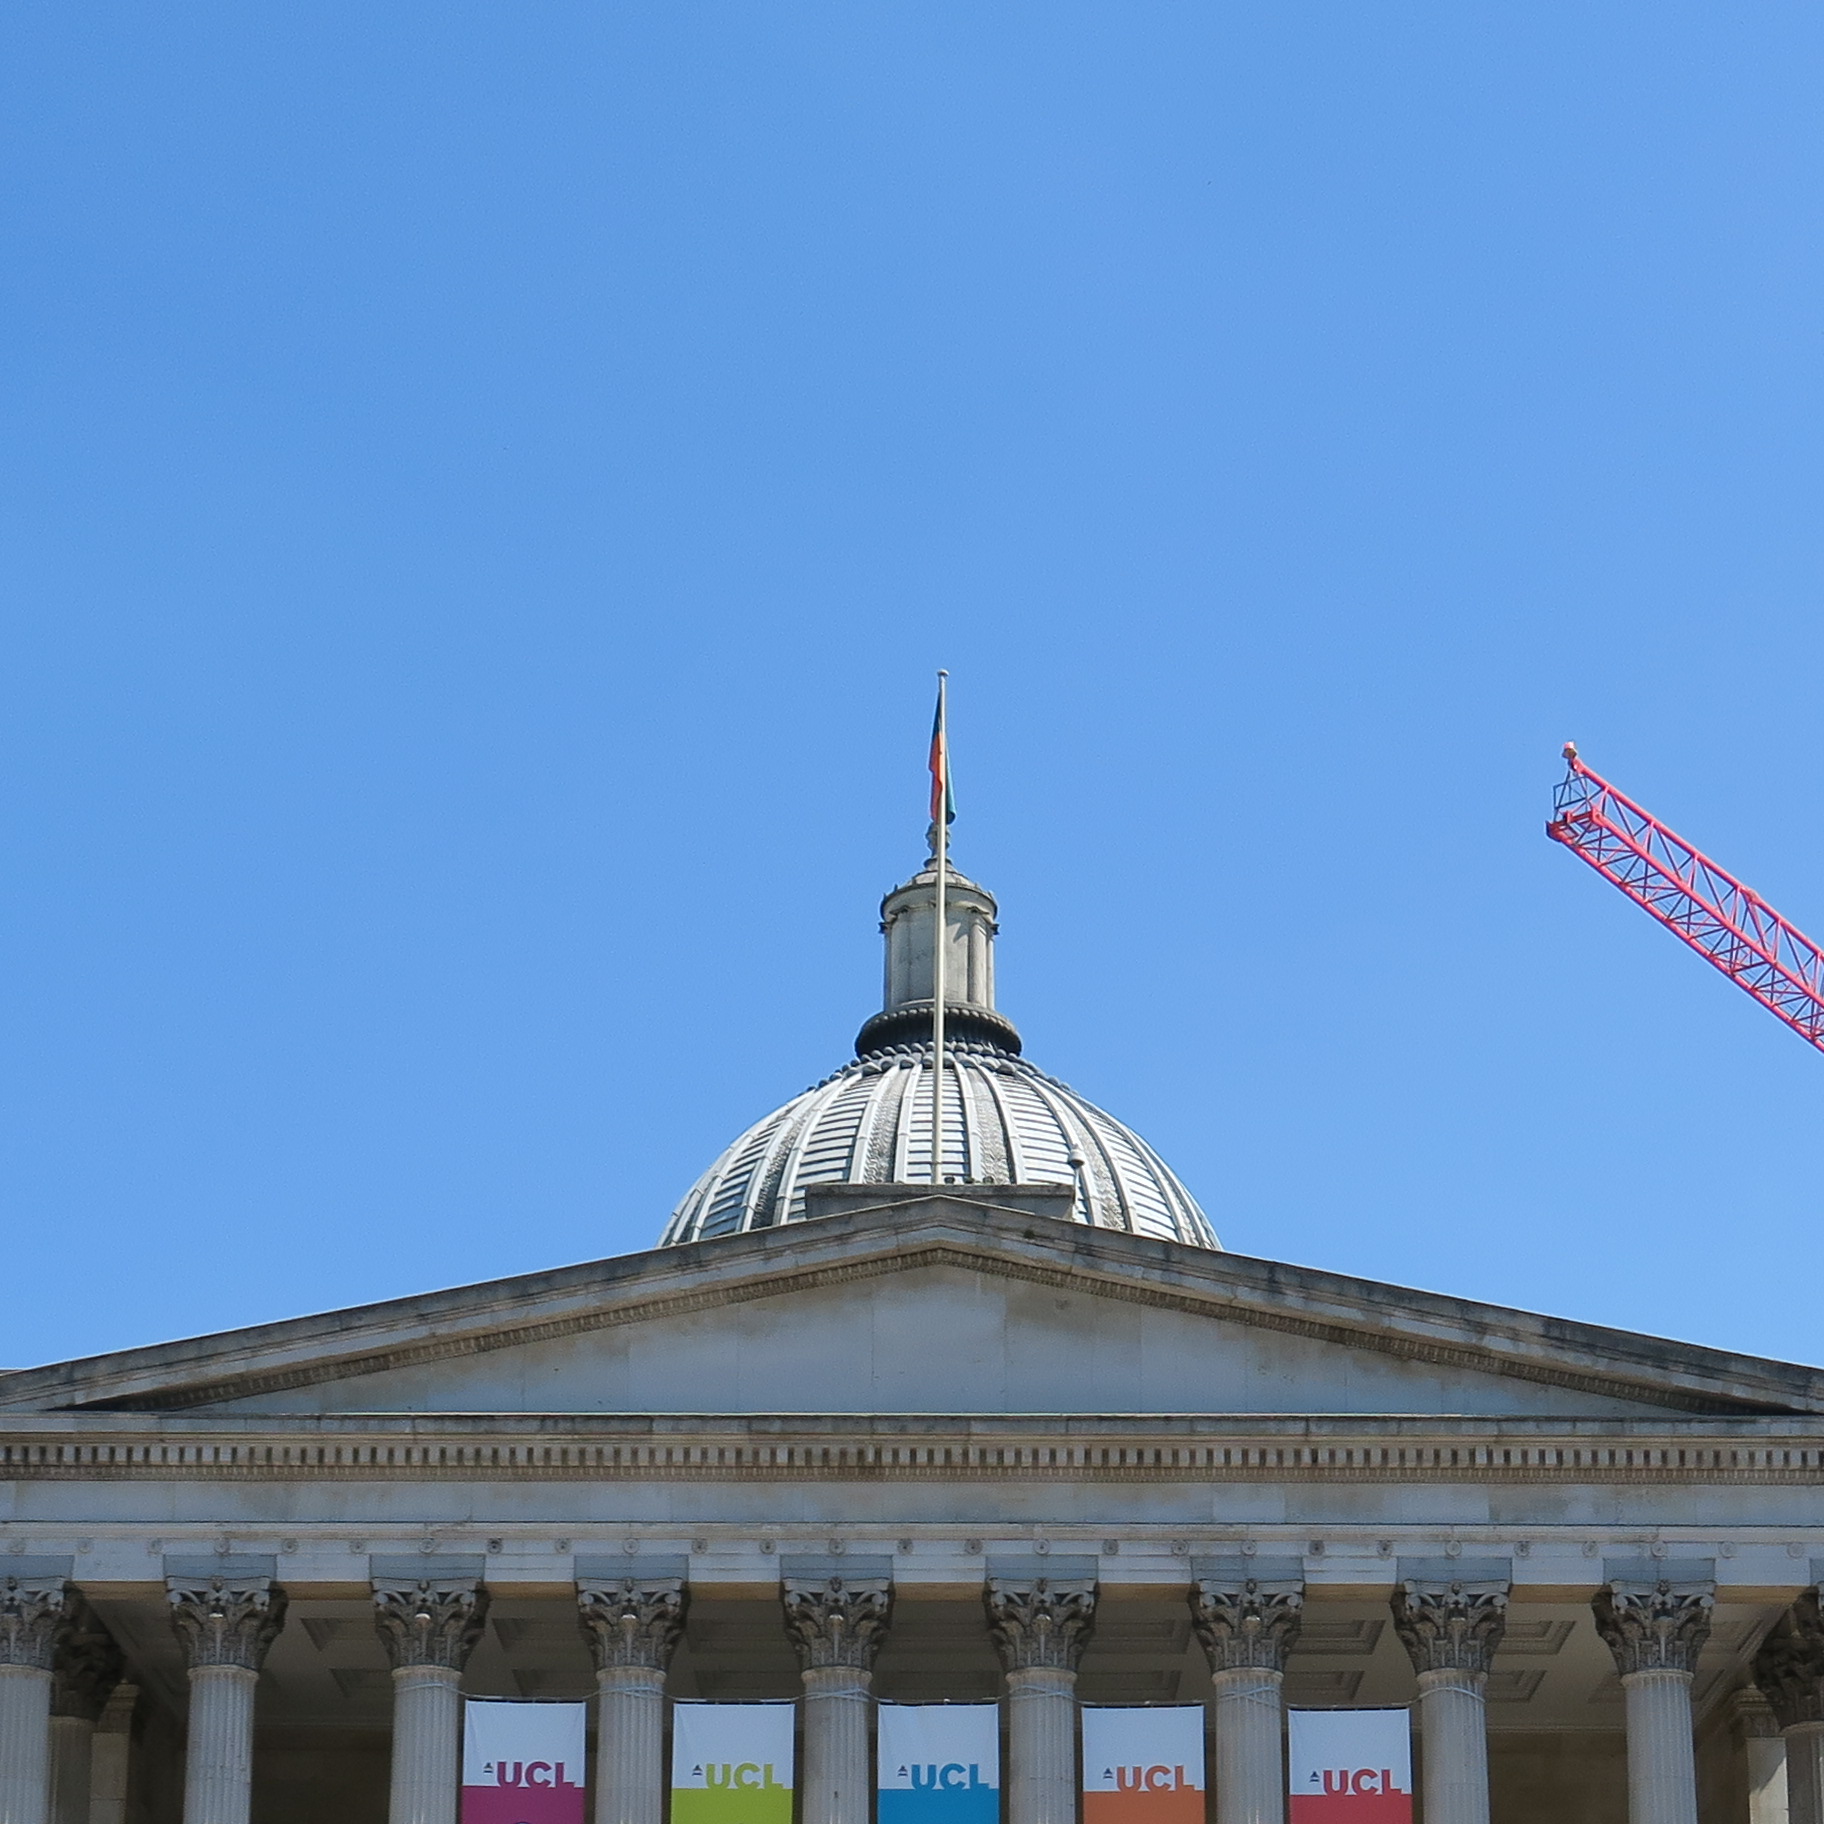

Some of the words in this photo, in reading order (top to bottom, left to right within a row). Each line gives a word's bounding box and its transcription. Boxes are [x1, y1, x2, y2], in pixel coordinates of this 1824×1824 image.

[496, 1761, 575, 1788] UCL
[705, 1762, 784, 1789] UCL
[910, 1763, 990, 1790] UCL
[1116, 1765, 1195, 1792] UCL
[1322, 1768, 1402, 1796] UCL
